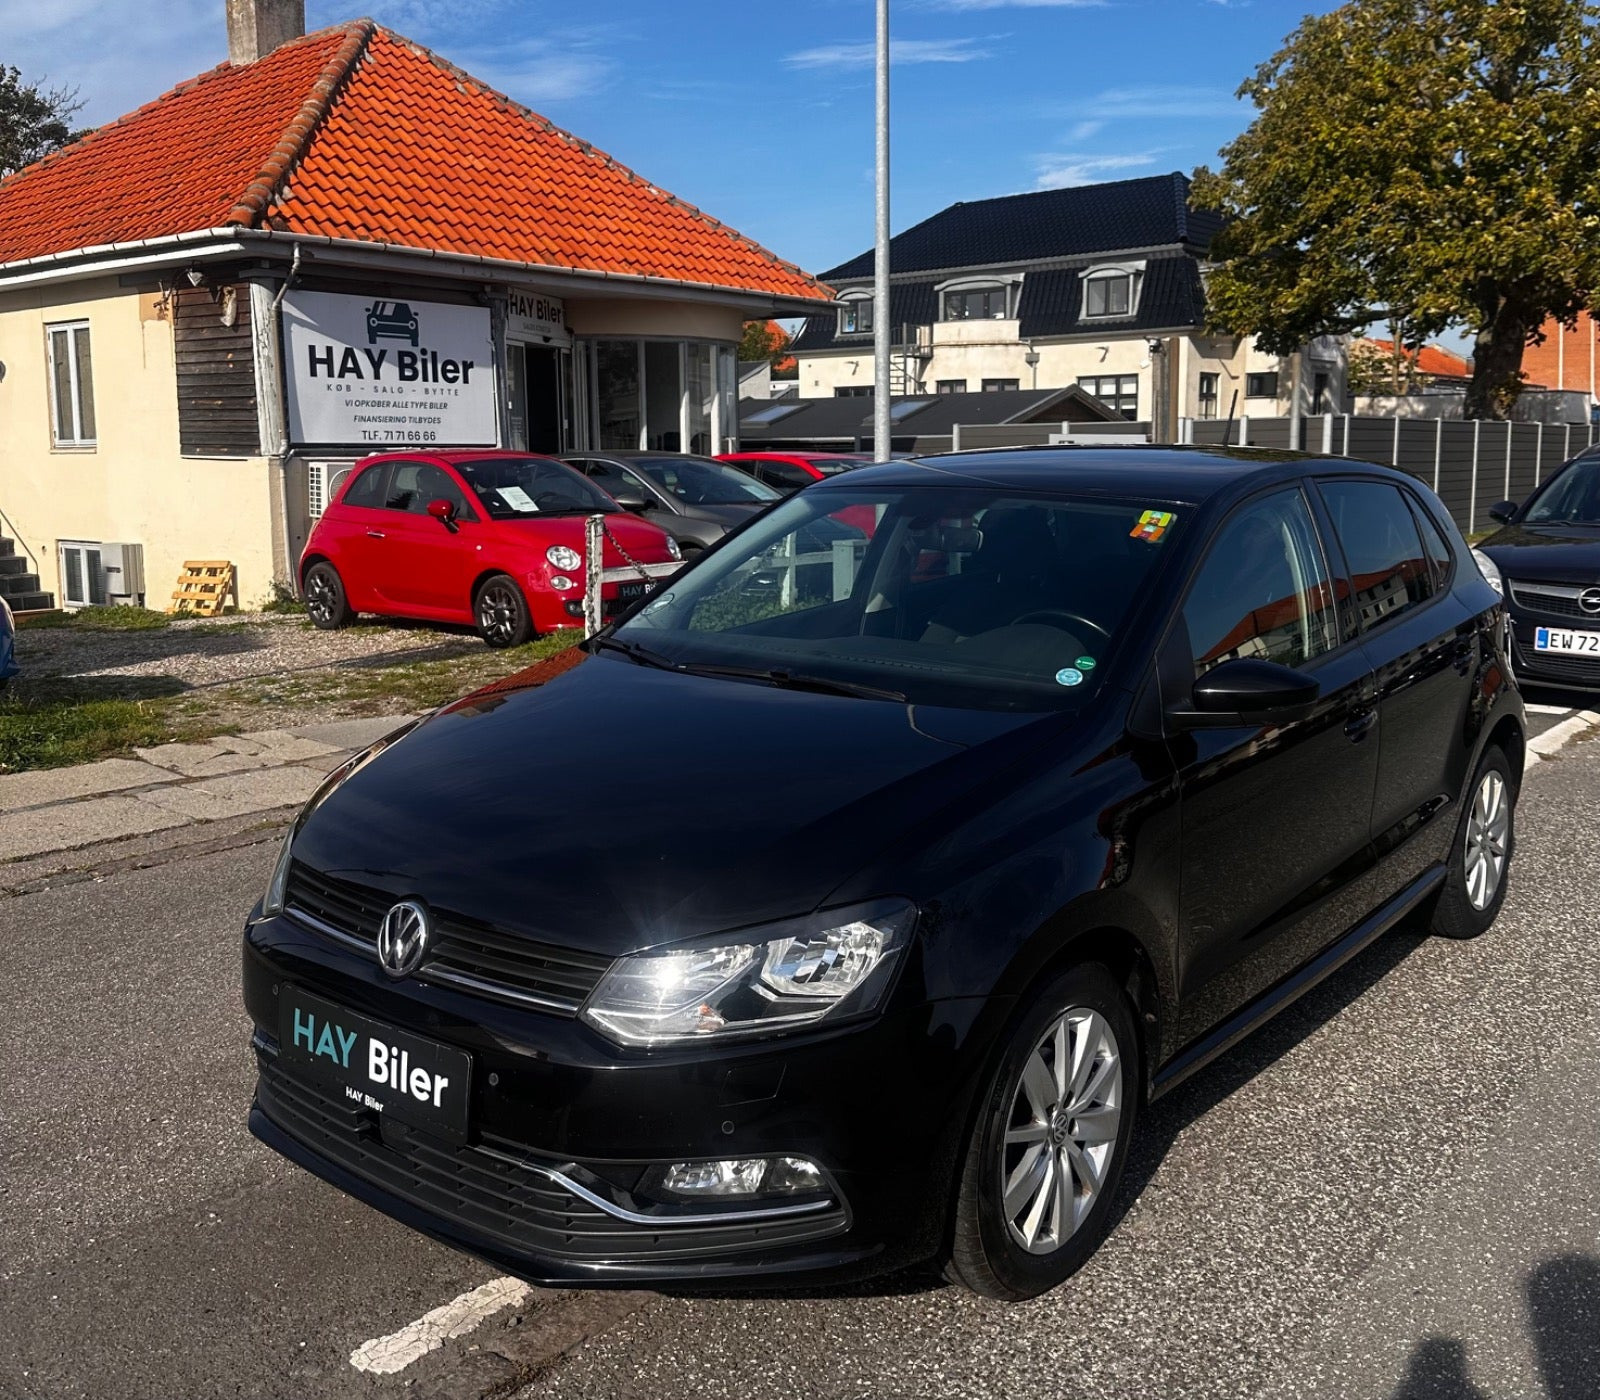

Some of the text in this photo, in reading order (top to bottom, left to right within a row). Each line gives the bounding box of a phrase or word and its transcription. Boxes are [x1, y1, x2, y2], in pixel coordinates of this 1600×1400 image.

[509, 293, 561, 324] HAY Biler
[308, 345, 474, 384] HAY Biler
[327, 384, 352, 392] KØB
[374, 386, 404, 394] SALG
[424, 388, 459, 396] BYTTE
[354, 400, 391, 408] OPKØBER
[392, 401, 409, 409] ALLE
[429, 402, 448, 410] BILER
[354, 415, 407, 424] FINANSIERING
[362, 430, 436, 441] TLF. 71 71 66 66
[622, 586, 641, 596] HAY
[1550, 633, 1573, 649] EW
[293, 1008, 448, 1108] HAY Biler
[346, 1086, 384, 1112] HAY Biler
